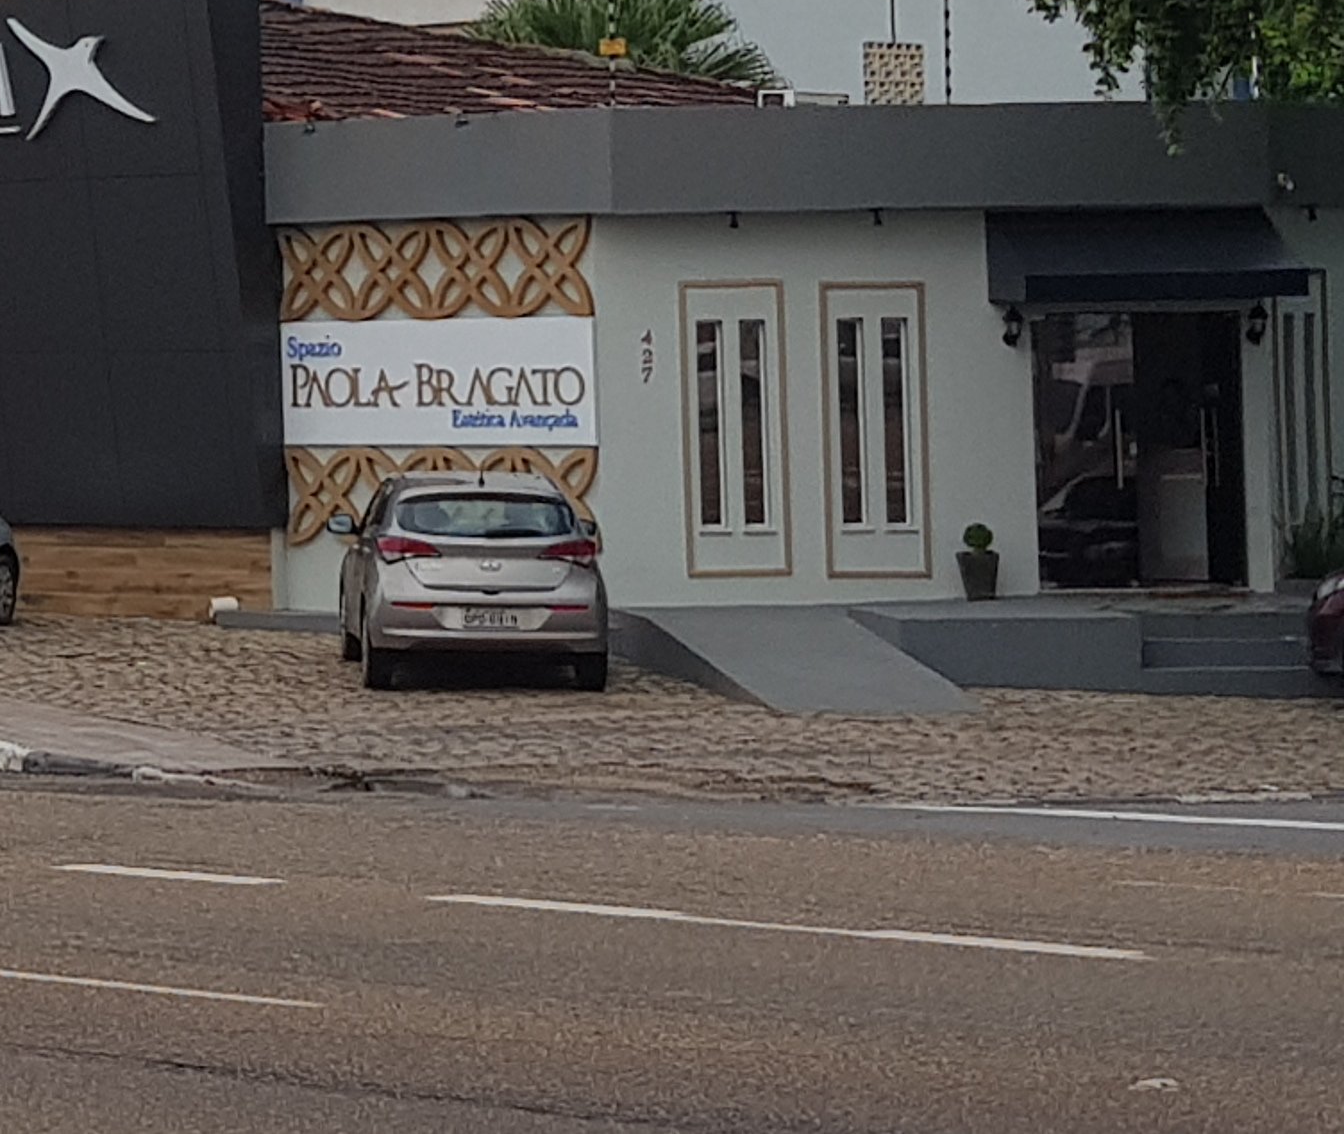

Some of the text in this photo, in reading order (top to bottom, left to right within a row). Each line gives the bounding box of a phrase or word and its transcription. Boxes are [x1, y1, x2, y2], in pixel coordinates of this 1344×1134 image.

[287, 335, 343, 360] Spazio
[640, 329, 653, 383] 427
[290, 362, 585, 408] PAOLA BRAGATO
[452, 409, 506, 429] Estética
